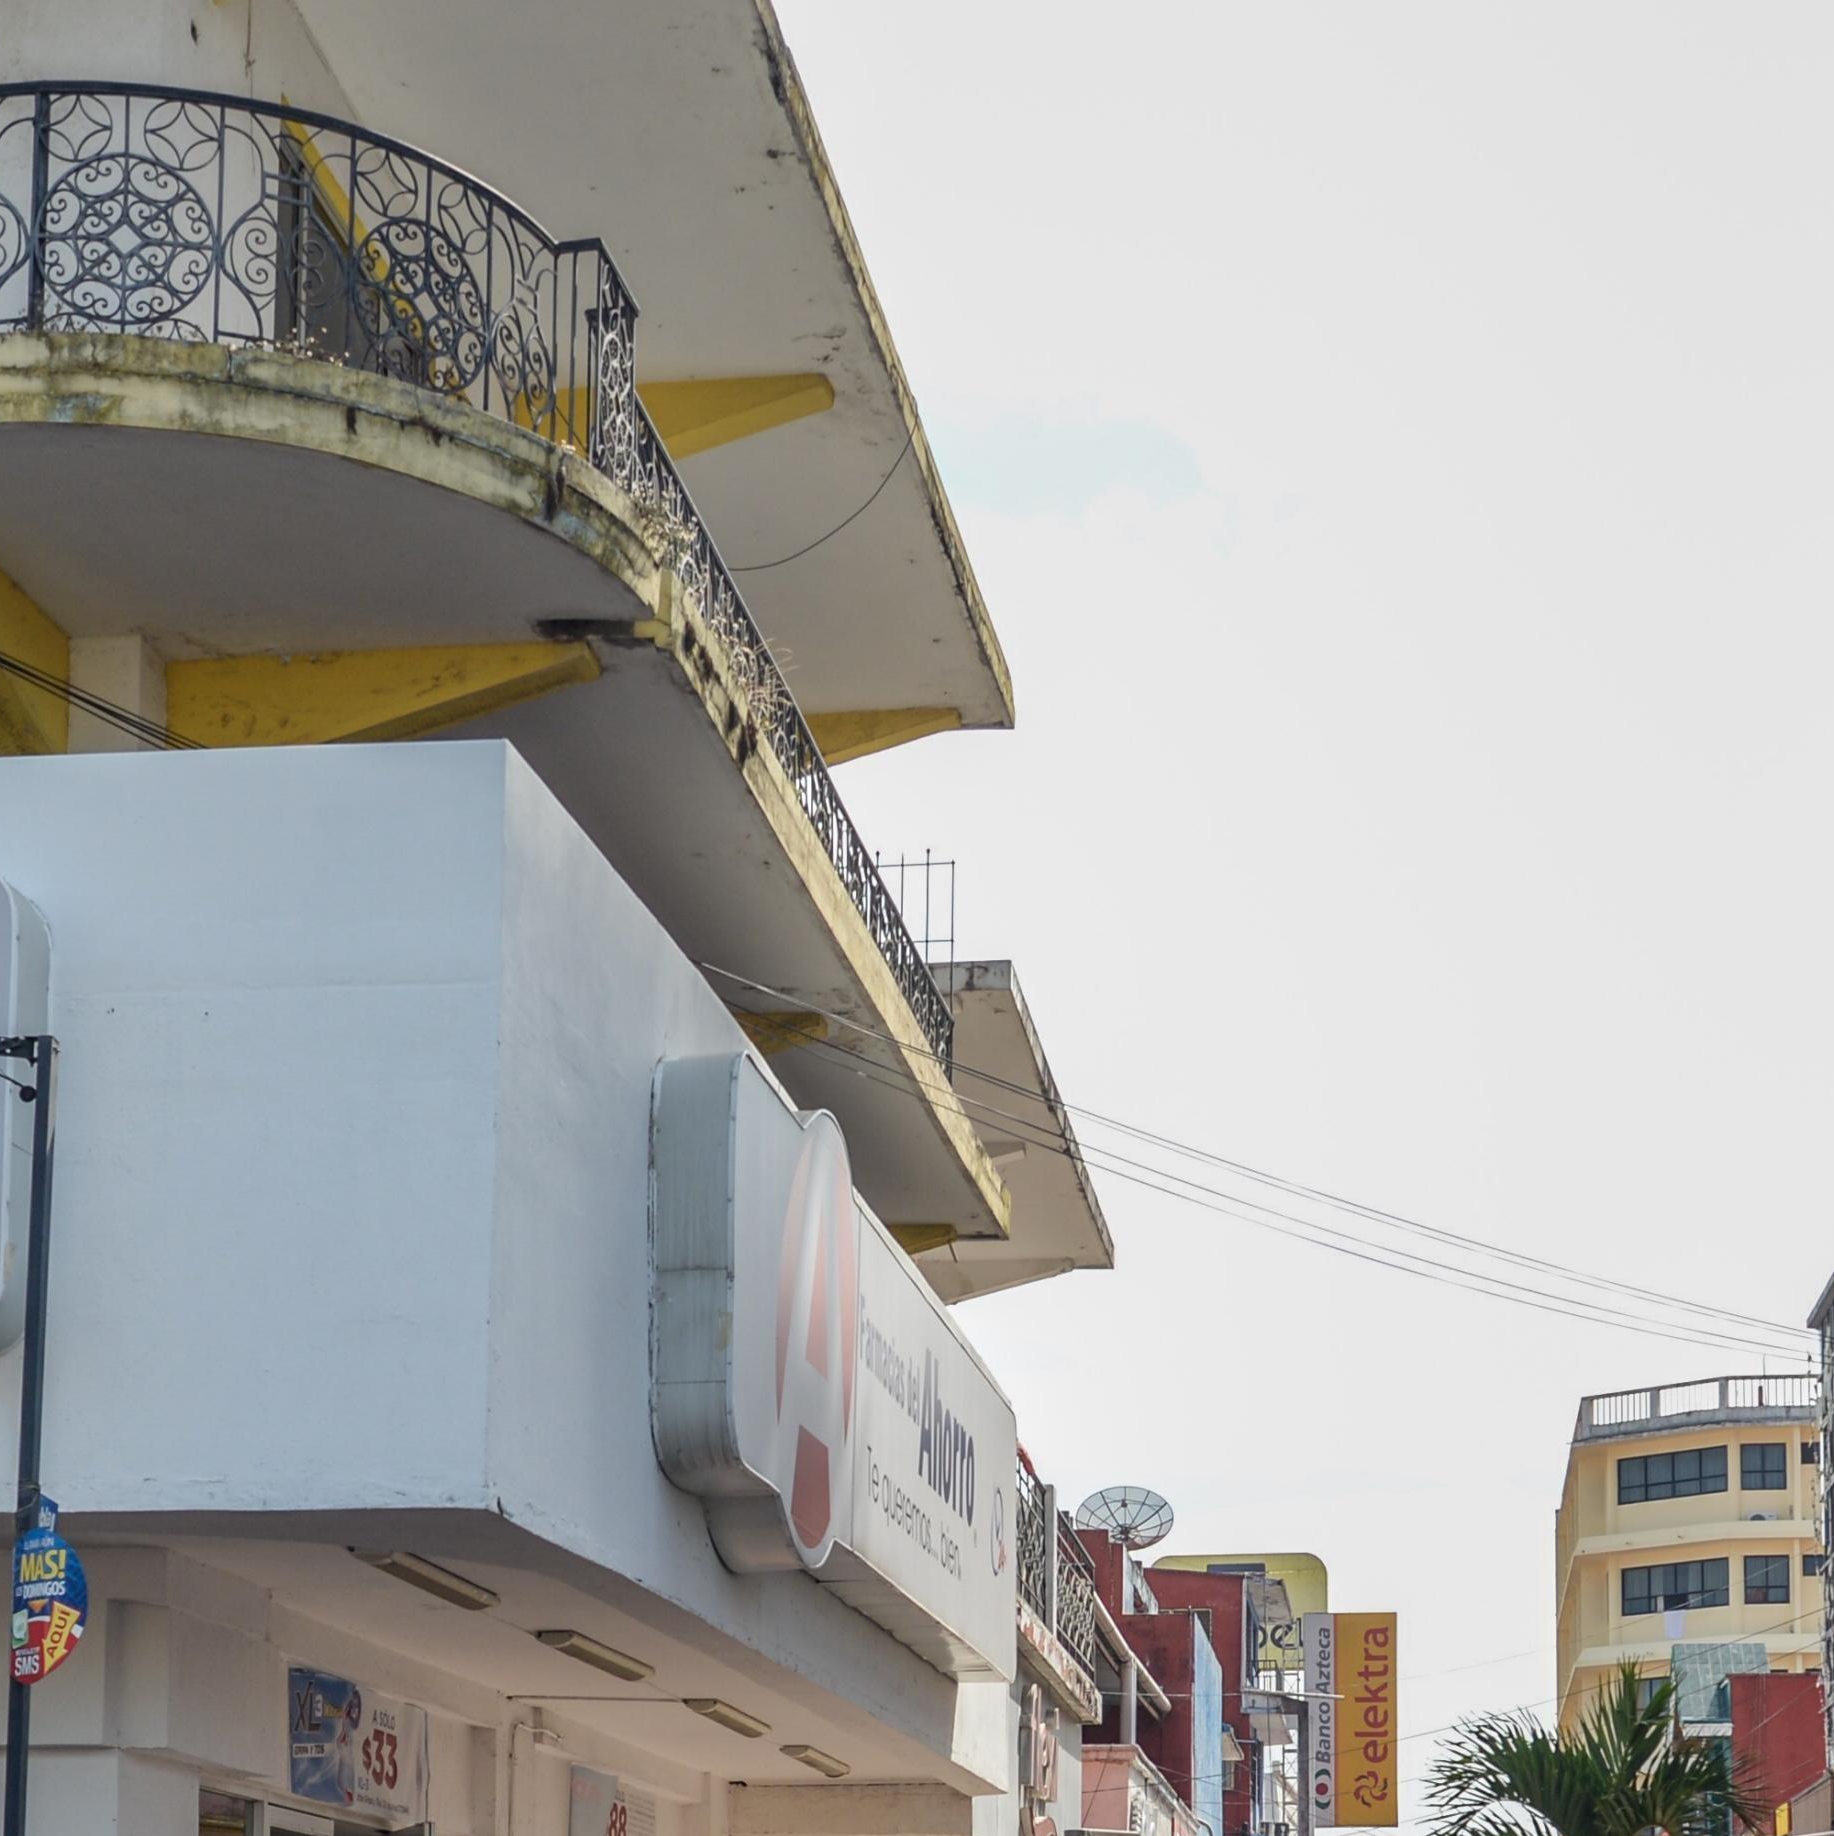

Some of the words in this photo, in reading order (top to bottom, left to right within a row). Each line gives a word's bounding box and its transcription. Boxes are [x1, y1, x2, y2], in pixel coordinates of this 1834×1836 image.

[859, 1292, 906, 1411] Farmacias
[907, 1356, 921, 1427] del
[918, 1347, 975, 1529] Ahorro
[866, 1444, 880, 1504] Te
[14, 1654, 40, 1677] SMS
[1315, 1626, 1332, 1695] Azteca
[1353, 1625, 1390, 1764] elektra
[362, 1728, 398, 1790] $33
[1315, 1700, 1332, 1764] Banco
